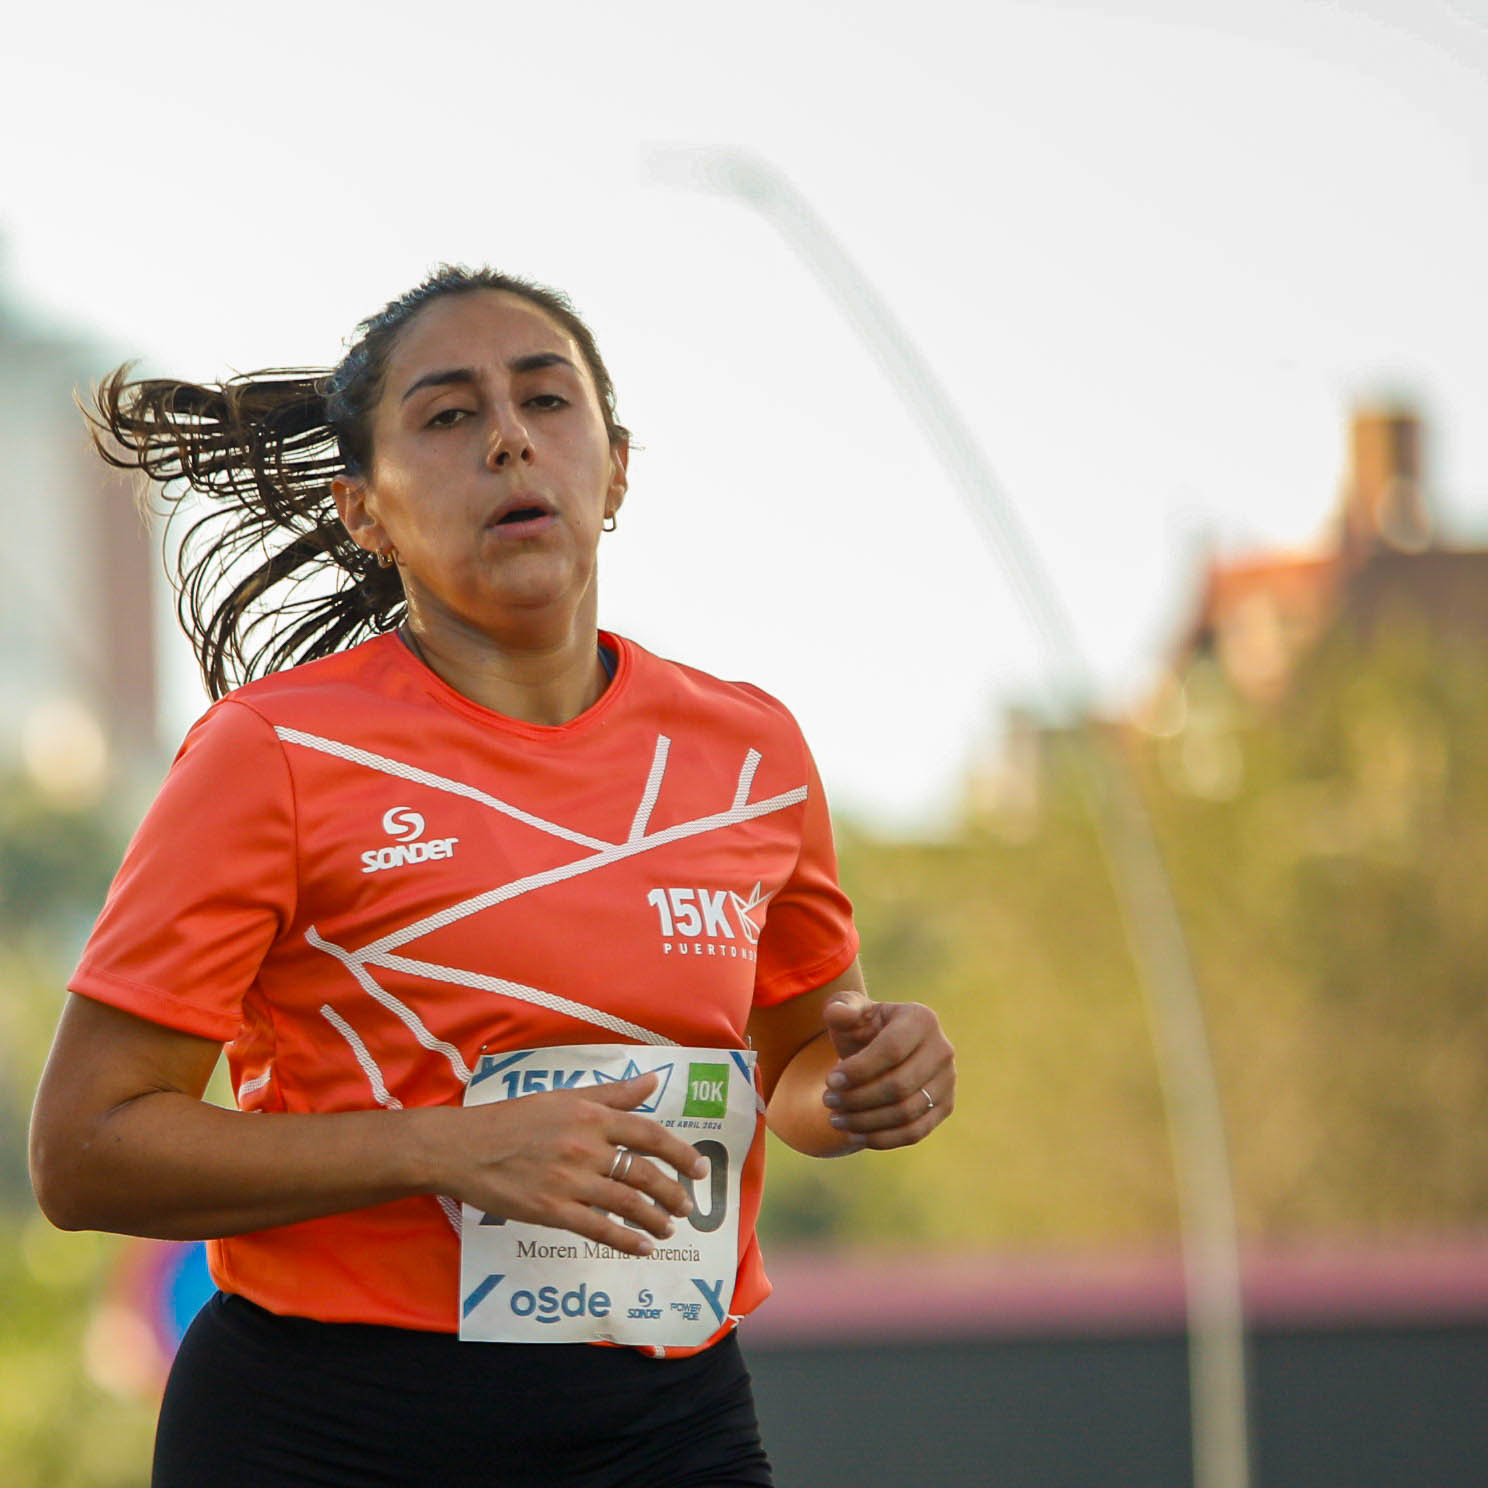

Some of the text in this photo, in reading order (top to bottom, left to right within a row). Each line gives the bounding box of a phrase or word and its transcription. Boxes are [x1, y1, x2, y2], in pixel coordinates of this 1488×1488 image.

[647, 887, 736, 939] 15K
[663, 942, 738, 958] PUERTO
[691, 1080, 723, 1102] 10K
[516, 1240, 578, 1259] Moren
[636, 1243, 701, 1262] orencia
[510, 1282, 612, 1320] osde
[670, 1302, 703, 1312] POWER
